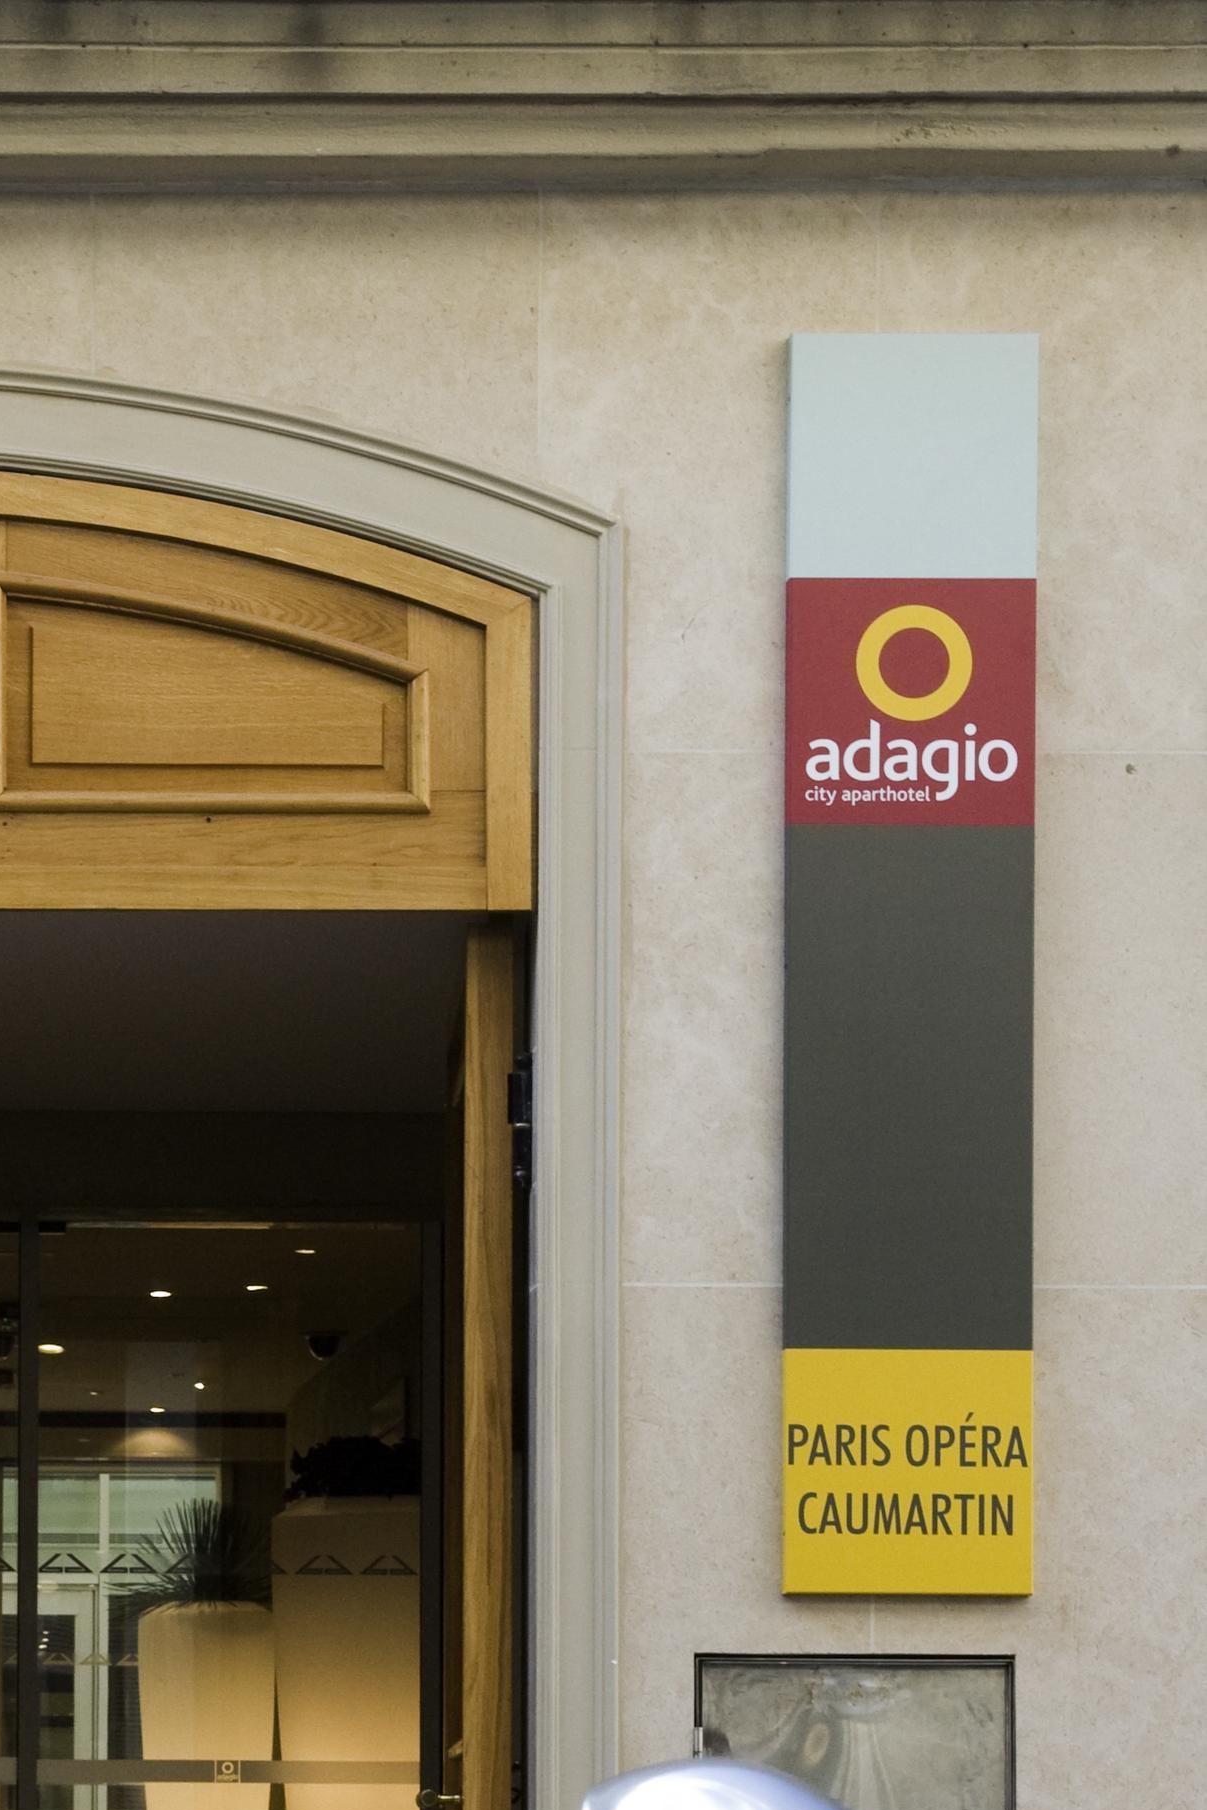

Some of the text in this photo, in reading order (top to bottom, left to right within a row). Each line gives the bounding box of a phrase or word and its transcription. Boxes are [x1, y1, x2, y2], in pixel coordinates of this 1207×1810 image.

[805, 719, 1019, 801] adagio
[804, 785, 931, 806] city aparthotel
[787, 1412, 1029, 1468] PARIS OPÉRA
[797, 1491, 1015, 1536] CAUMARTIN
